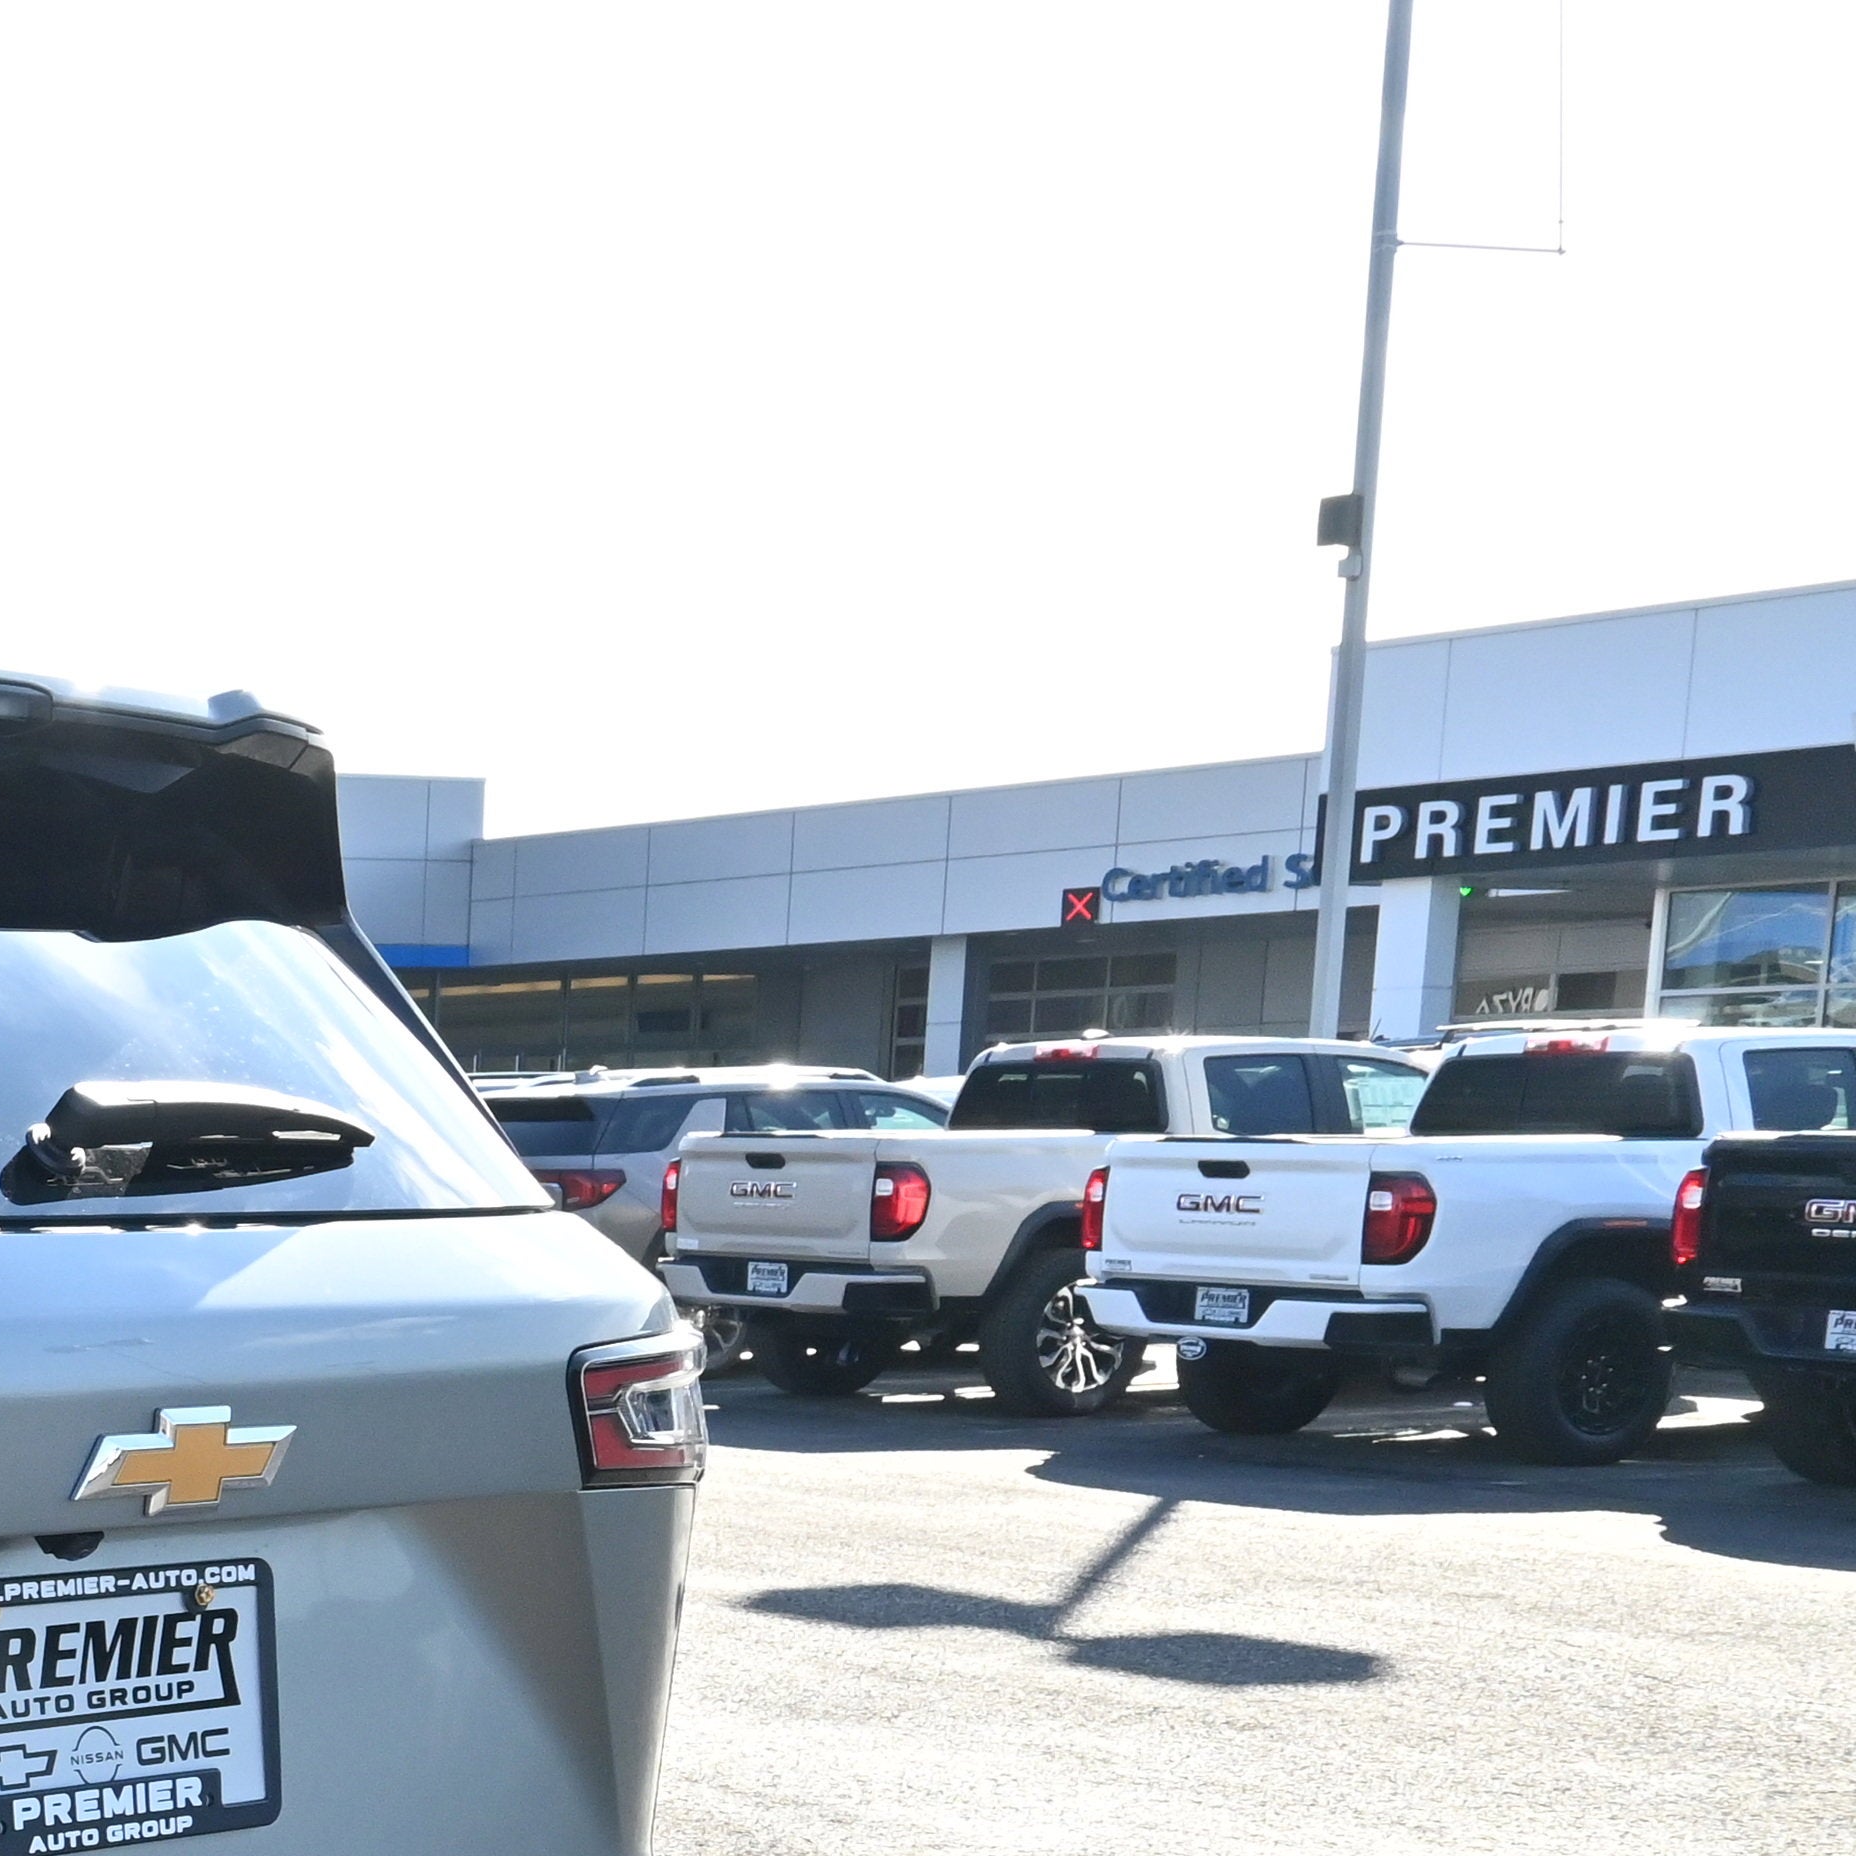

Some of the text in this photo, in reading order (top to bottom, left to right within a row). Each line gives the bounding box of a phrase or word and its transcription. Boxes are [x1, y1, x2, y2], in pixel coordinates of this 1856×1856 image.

[1360, 774, 1754, 863] PREMIER
[1102, 855, 1271, 902] Certified
[730, 1181, 797, 1199] GMC
[1176, 1193, 1265, 1214] GMC
[1201, 1293, 1248, 1305] PREMIER
[1833, 1317, 1856, 1329] PR
[86, 1681, 195, 1710] GROUP
[70, 1727, 230, 1766] NISSAN GMC
[12, 1776, 203, 1831] PREMIER
[28, 1815, 193, 1854] AUTO GROUP
